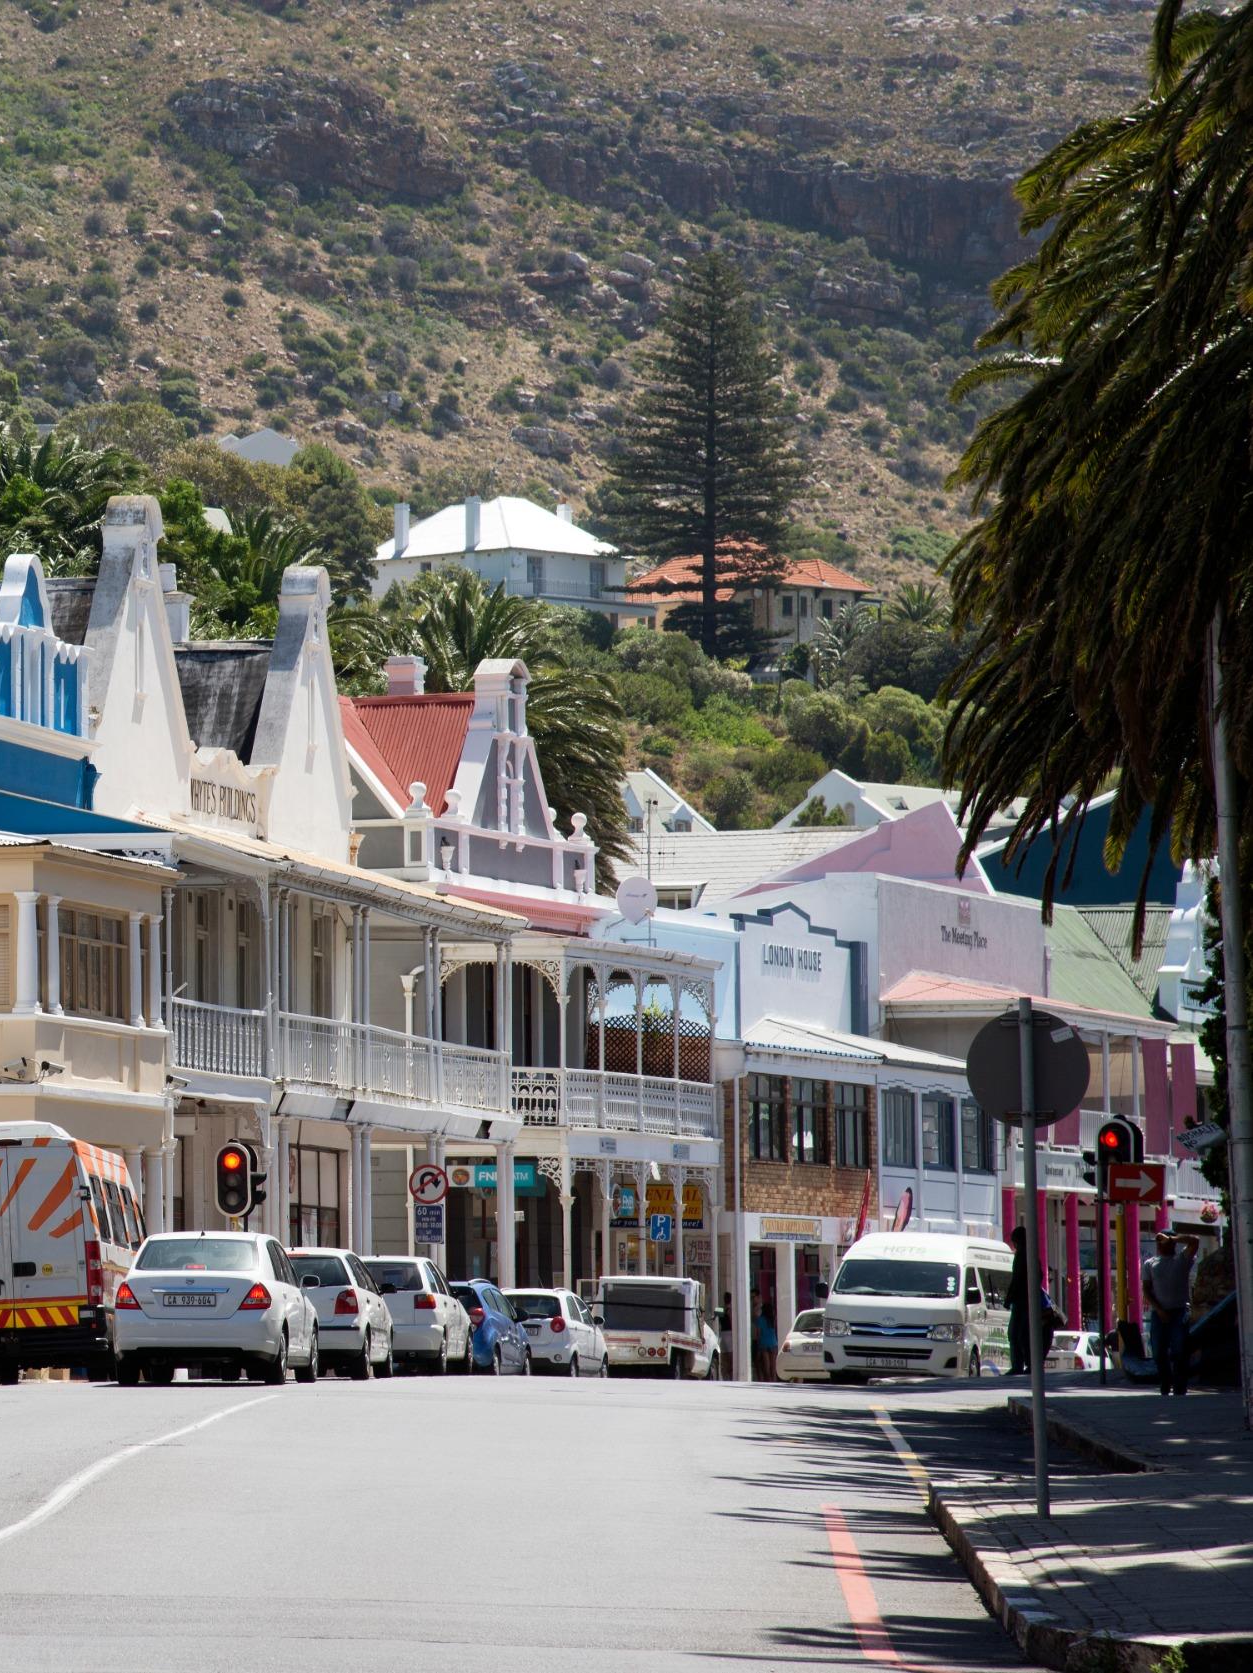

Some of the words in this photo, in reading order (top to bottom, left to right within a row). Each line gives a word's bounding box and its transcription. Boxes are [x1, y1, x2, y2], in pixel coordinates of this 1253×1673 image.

[219, 785, 256, 825] BUILDINGS
[941, 925, 950, 942] The
[951, 927, 973, 951] Meeting
[974, 931, 987, 949] Place
[762, 943, 794, 968] LONDON
[798, 948, 822, 972] HOUSE
[478, 1171, 498, 1182] FN
[417, 1207, 427, 1216] 60
[624, 1221, 638, 1229] you
[167, 1296, 177, 1305] CA
